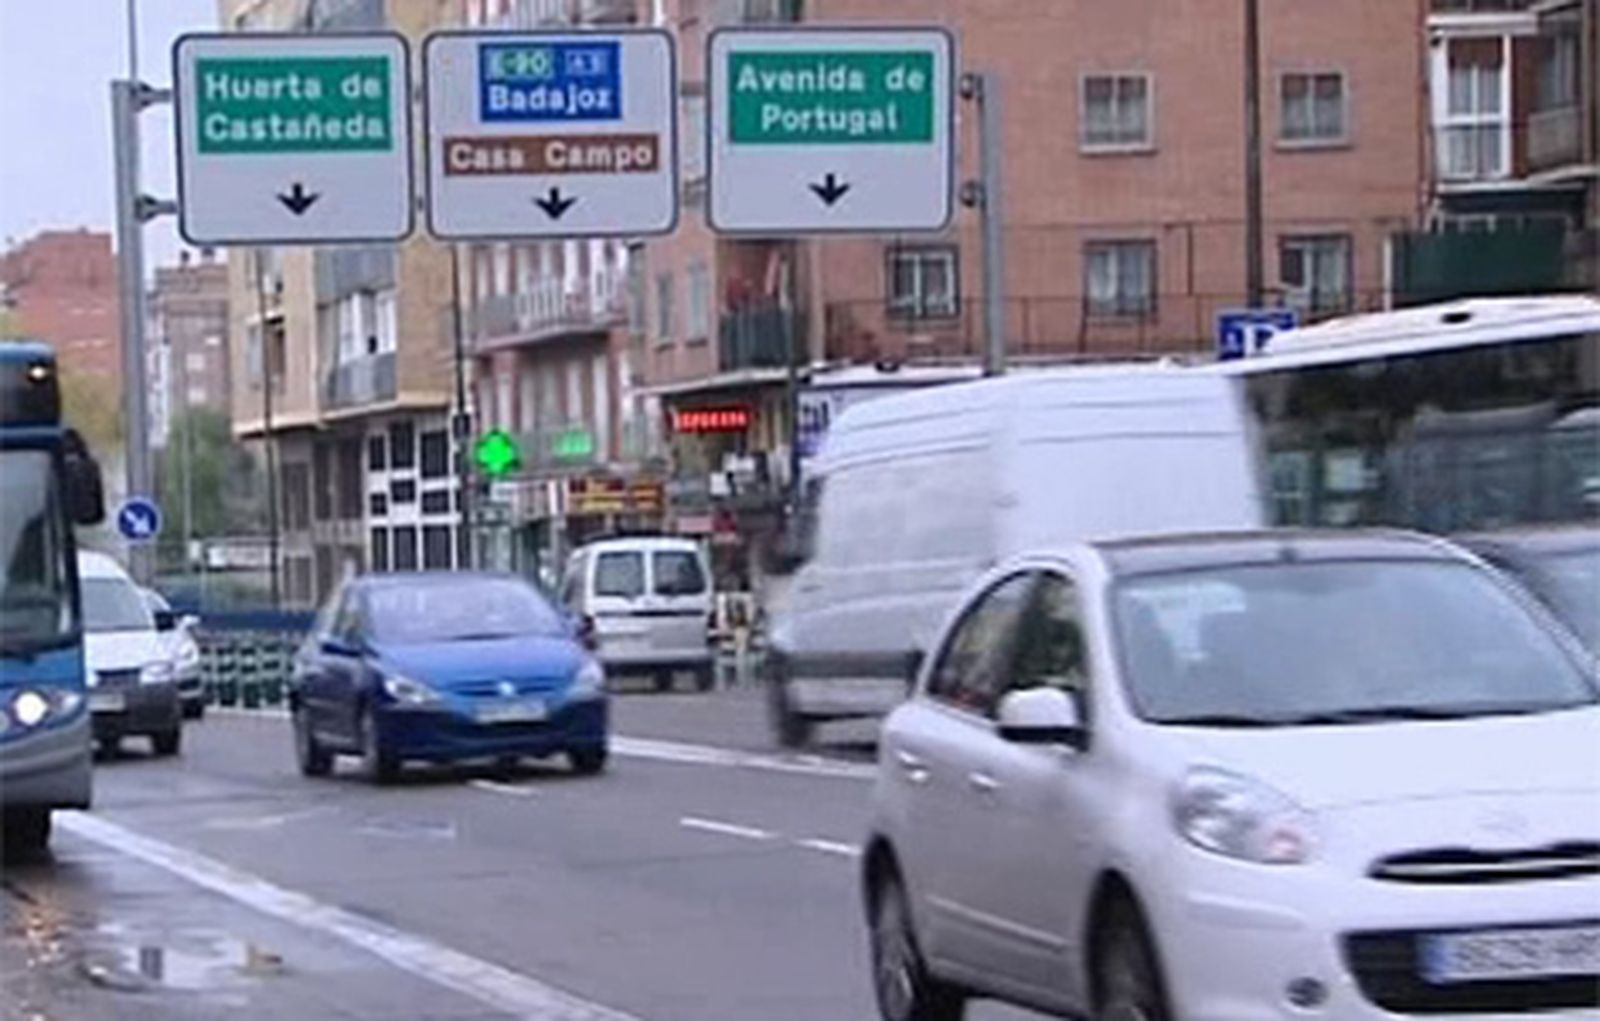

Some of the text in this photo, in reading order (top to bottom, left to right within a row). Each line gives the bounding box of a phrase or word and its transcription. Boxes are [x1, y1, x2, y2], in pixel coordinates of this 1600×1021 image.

[205, 72, 382, 99] Huerta de
[736, 64, 925, 91] Avenida de
[489, 83, 610, 115] Badajoz
[204, 112, 385, 141] Castañeda
[761, 104, 897, 135] Portugal
[450, 140, 653, 171] Casa Campo
